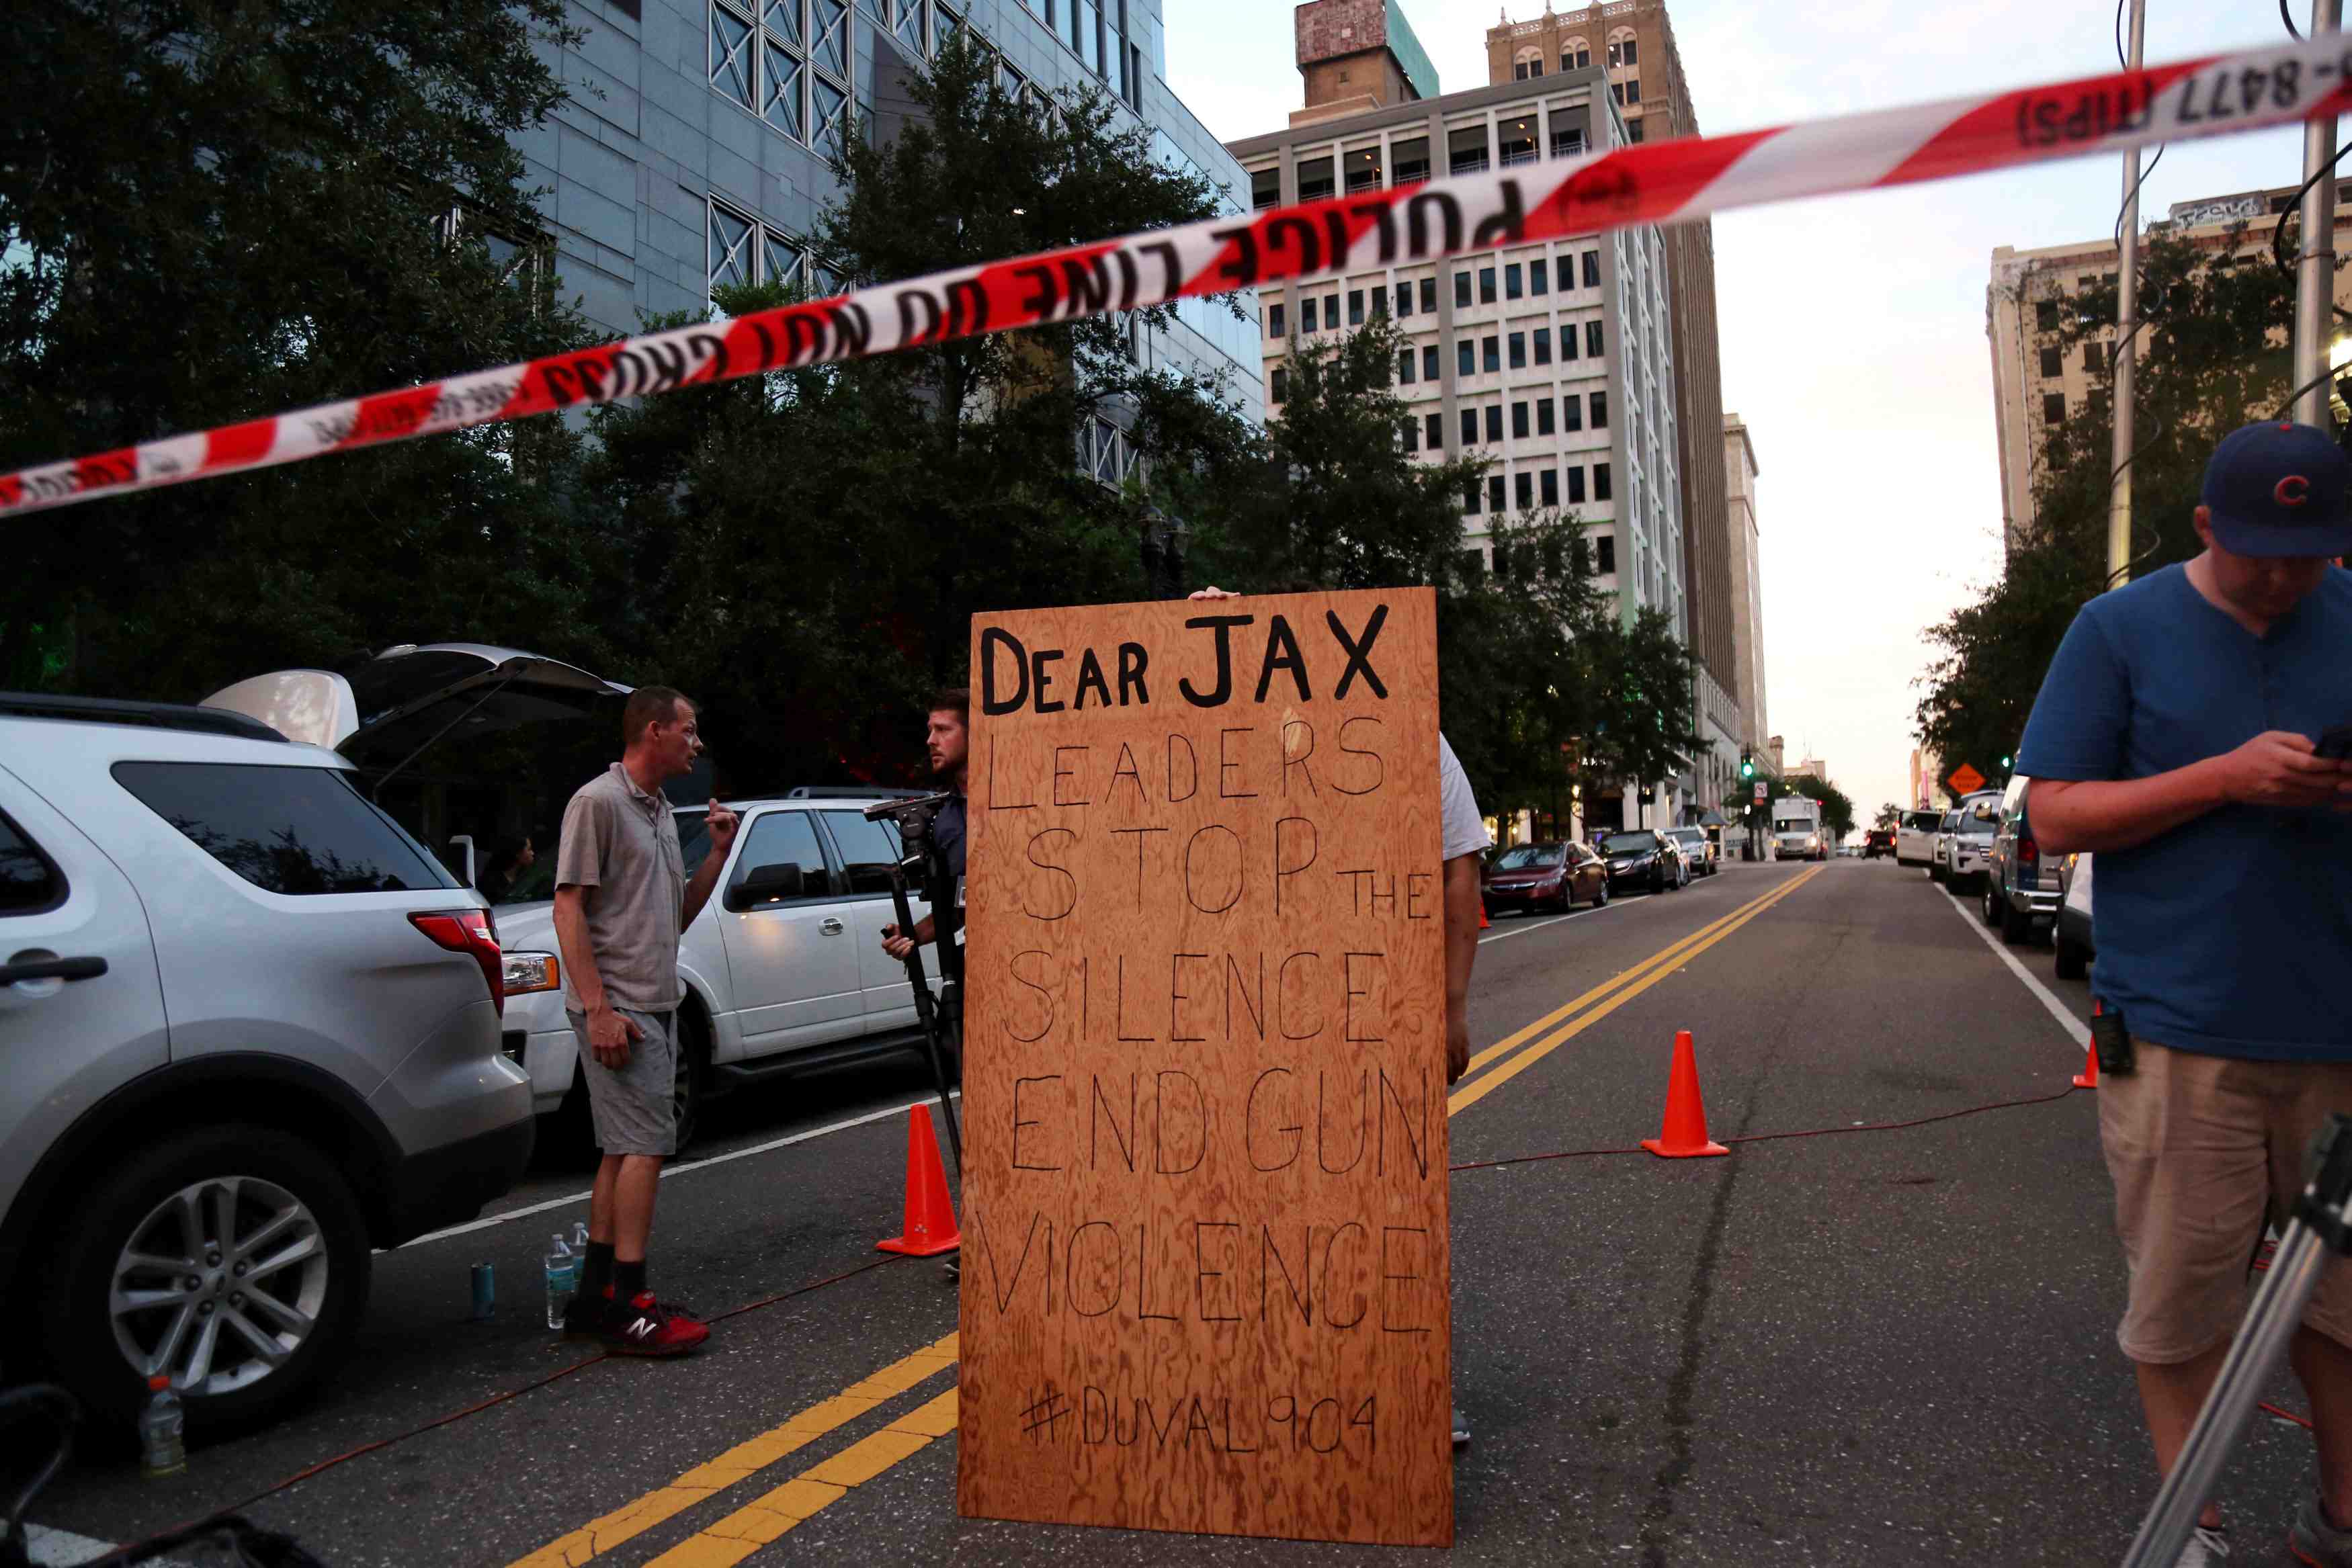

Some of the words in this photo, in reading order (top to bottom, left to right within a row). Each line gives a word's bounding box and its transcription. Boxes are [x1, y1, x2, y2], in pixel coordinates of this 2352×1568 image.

[2017, 78, 2155, 147] (TIPS)
[1021, 241, 1181, 318] LINE
[2274, 474, 2310, 505] C
[980, 626, 1150, 716] DEAR
[1178, 604, 1390, 709] JAX
[988, 716, 1384, 810] LEADERS
[1022, 816, 1318, 921] STOP
[1336, 870, 1433, 919] THE
[1003, 950, 1384, 1042] SILENCE
[1012, 1070, 1208, 1174] END
[1246, 1067, 1427, 1182] GUN
[974, 1210, 1432, 1332] VIOLENCE
[626, 1317, 657, 1340] N
